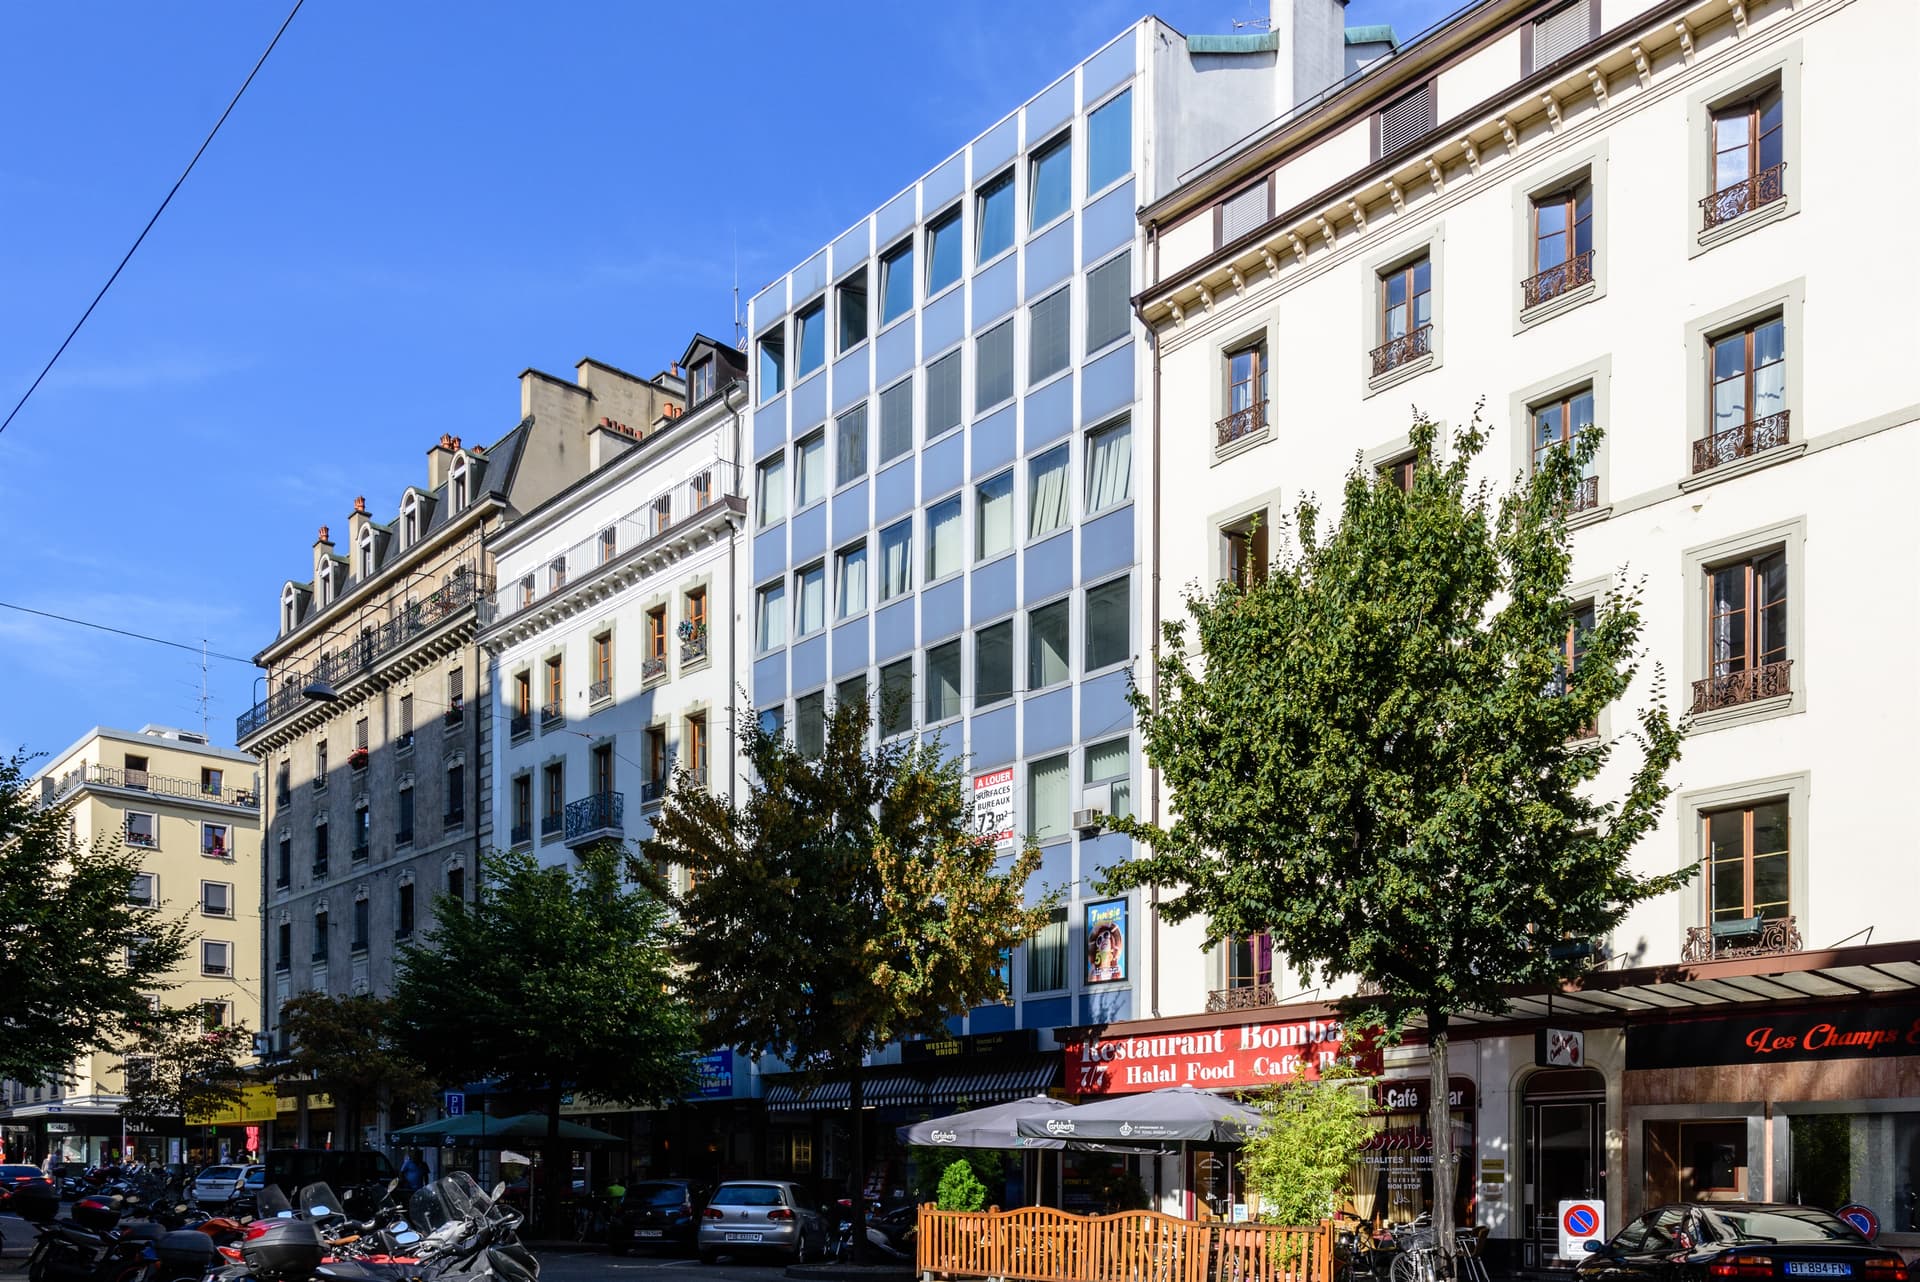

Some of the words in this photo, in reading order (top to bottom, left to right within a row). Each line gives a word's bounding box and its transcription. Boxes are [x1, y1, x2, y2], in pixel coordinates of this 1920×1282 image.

[977, 779, 984, 788] A
[985, 772, 1011, 786] LOUER
[977, 785, 1011, 800] SURFACES
[977, 796, 1010, 811] BUREAUX
[925, 1040, 959, 1051] WESTERN
[1079, 1029, 1225, 1063] Restaurant
[1238, 1017, 1345, 1051] Bomba
[1745, 1027, 1797, 1054] Les
[1802, 1023, 1899, 1051] Champs
[935, 1048, 959, 1056] UNION
[1080, 1066, 1108, 1087] 7/7
[1126, 1063, 1177, 1085] Halal
[1185, 1059, 1235, 1081] Food
[1387, 1088, 1418, 1108] Café
[1449, 1090, 1464, 1105] ar
[1046, 1119, 1075, 1135] Carlsberg
[931, 1130, 957, 1143] Carlsberg
